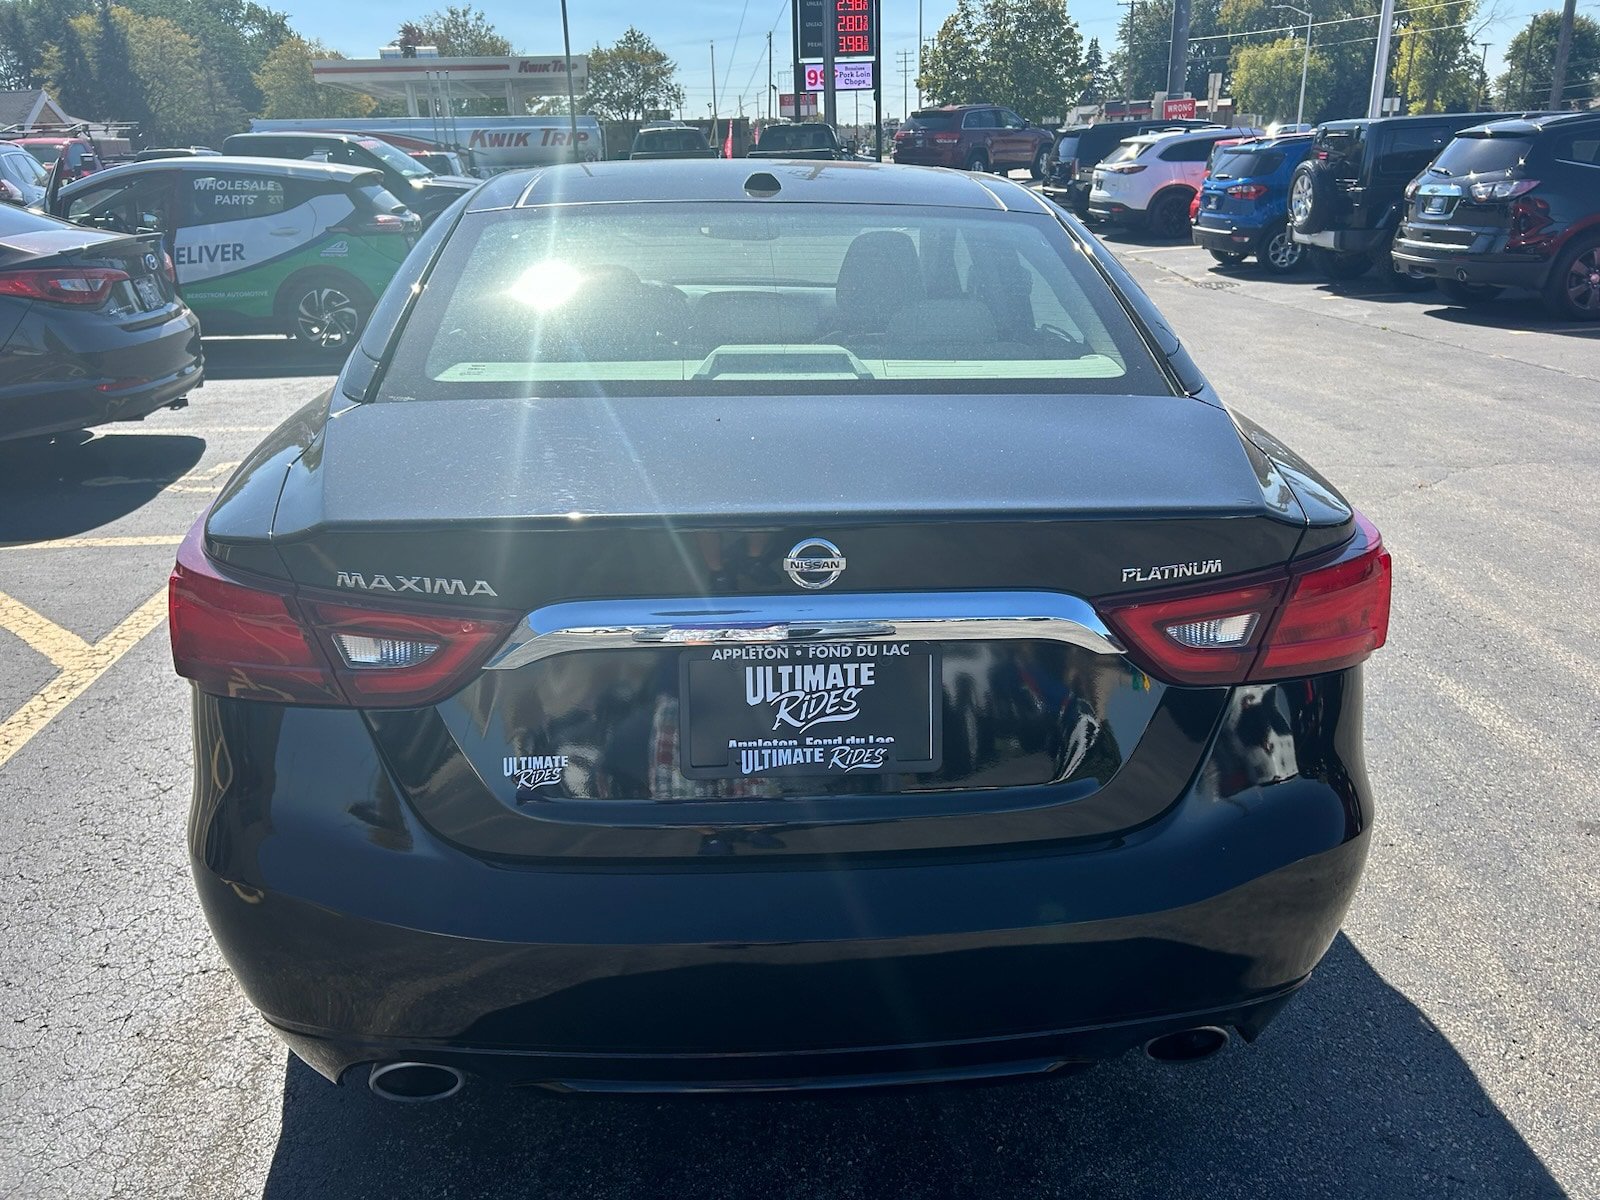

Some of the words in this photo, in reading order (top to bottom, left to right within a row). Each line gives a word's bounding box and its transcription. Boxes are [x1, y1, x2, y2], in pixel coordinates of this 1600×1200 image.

[551, 60, 578, 73] TRP
[844, 78, 866, 87] Chops
[1167, 103, 1193, 113] WRONG
[468, 129, 532, 148] KWIK
[539, 128, 590, 147] TRIP
[193, 179, 275, 191] WHOLESALE
[214, 194, 257, 205] PARTS
[175, 242, 246, 265] ELIVER
[790, 561, 840, 569] NISSAN
[1121, 559, 1223, 583] PLATINUM
[336, 570, 499, 597] MAXIMA
[711, 647, 790, 661] APPLETON
[808, 645, 853, 659] FOND
[856, 644, 878, 658] DU
[882, 643, 911, 656] LAC
[745, 662, 876, 707] ULTIMATE
[503, 755, 569, 777] ULTIMATE
[741, 747, 825, 775] ULTIMATE
